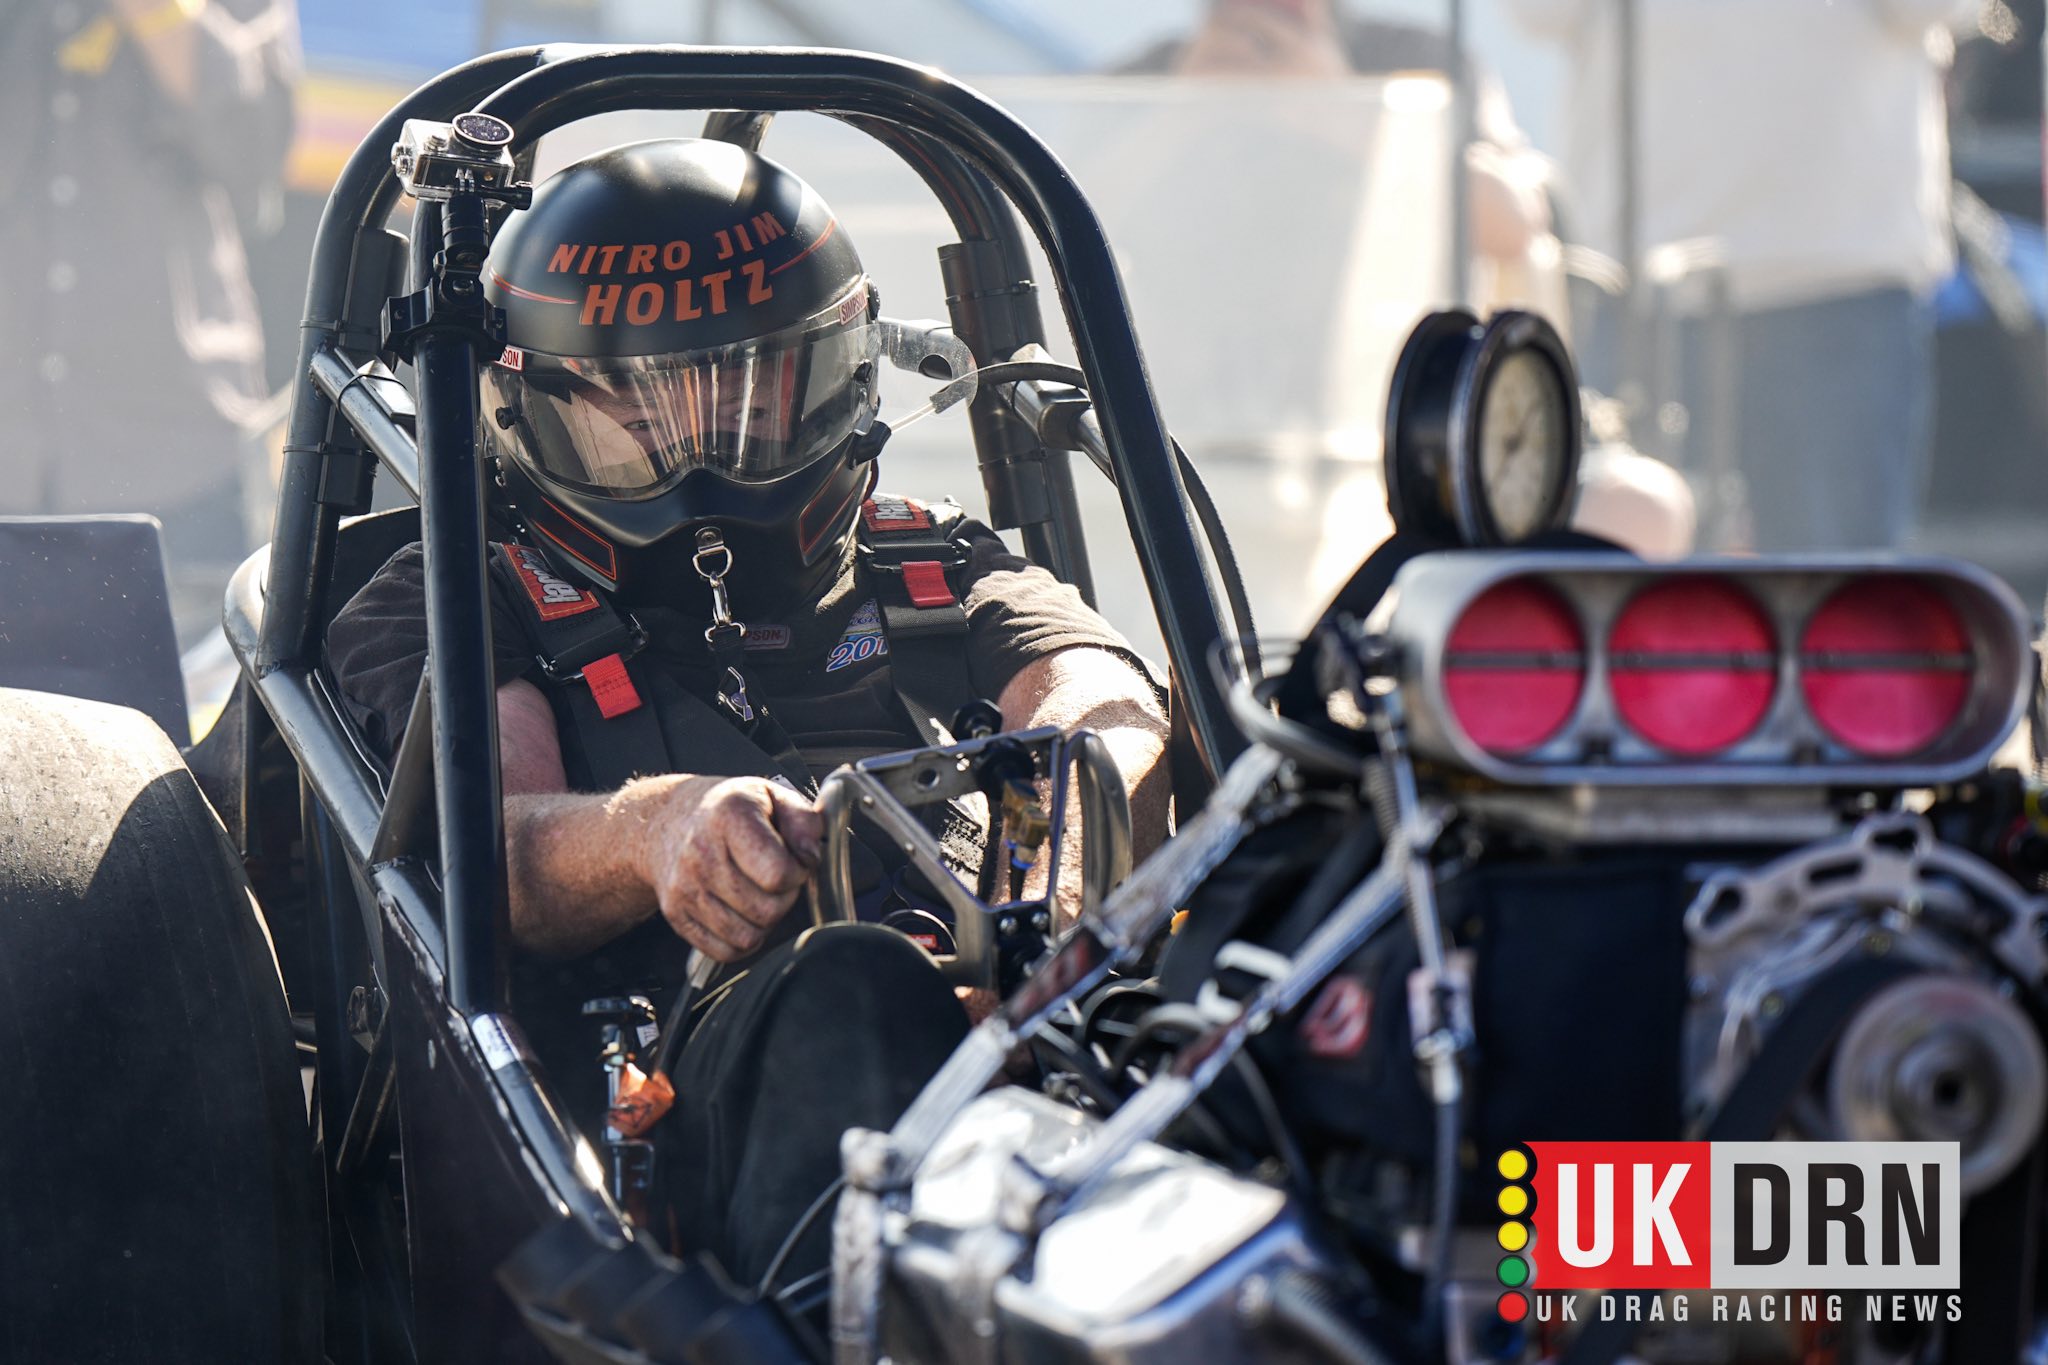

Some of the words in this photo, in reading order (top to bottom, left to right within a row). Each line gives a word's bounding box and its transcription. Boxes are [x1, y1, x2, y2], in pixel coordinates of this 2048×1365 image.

[547, 239, 691, 275] NITRO
[714, 211, 787, 261] JIM
[578, 258, 775, 327] HOLTZ
